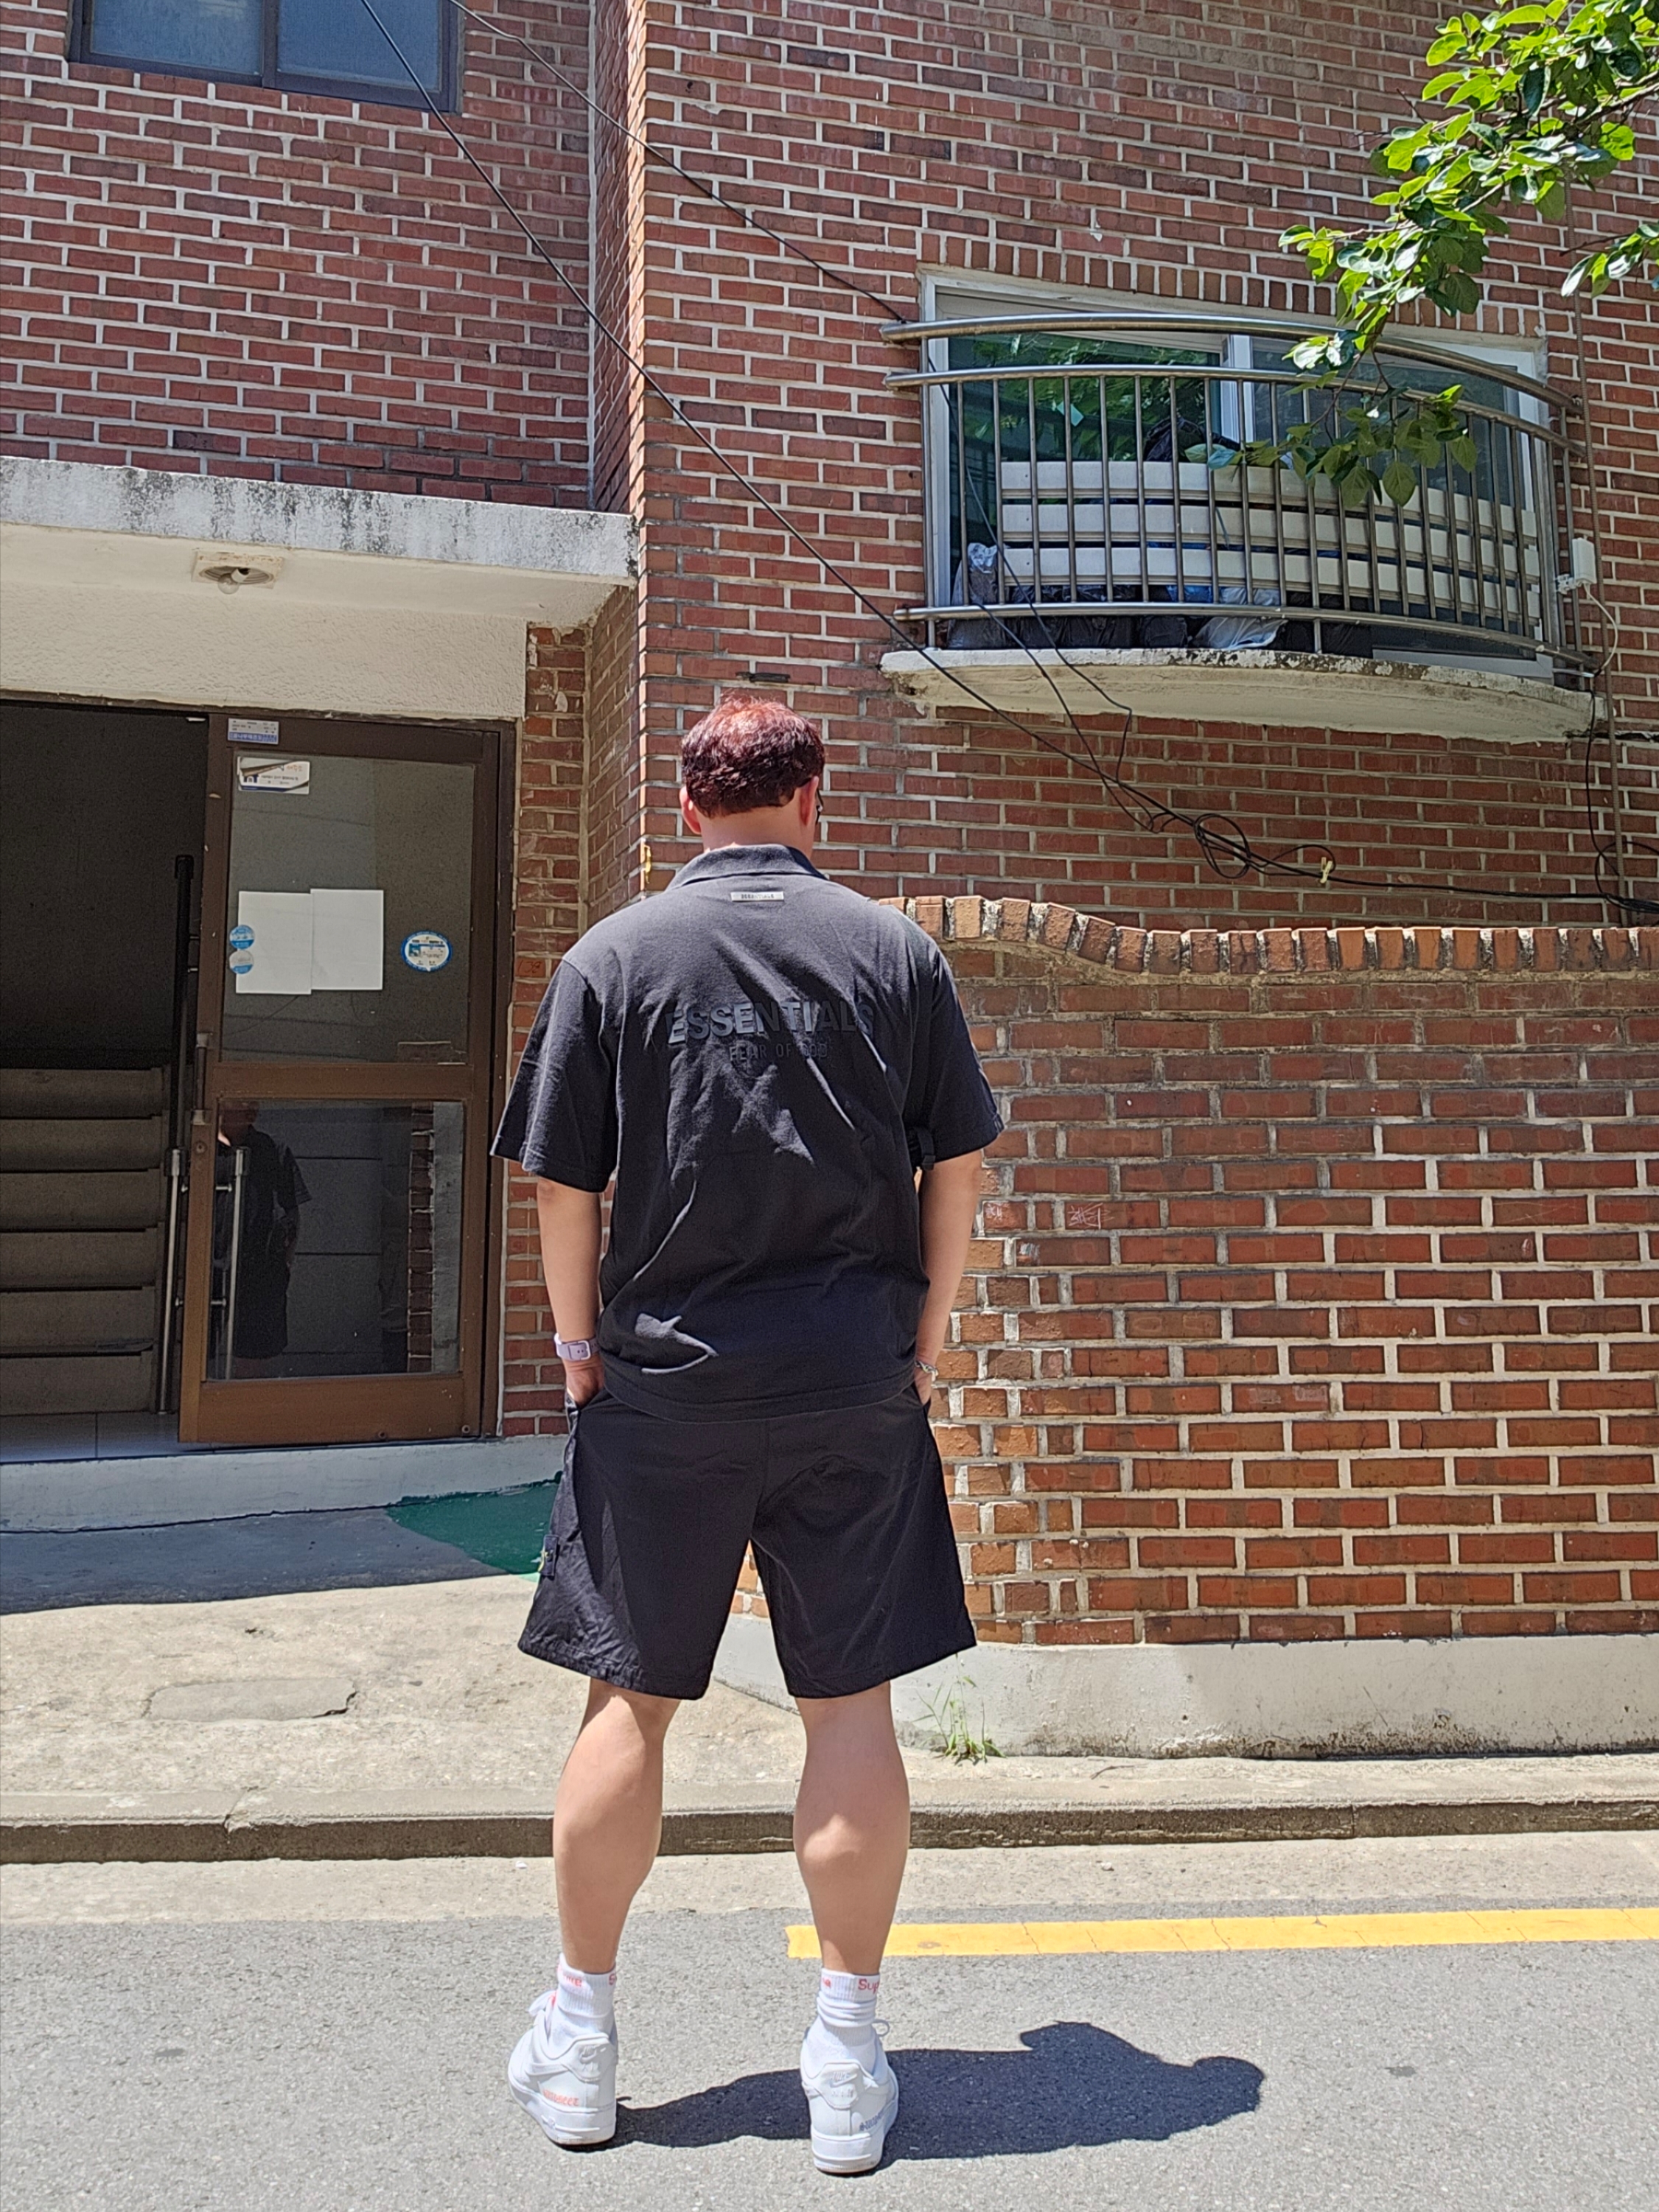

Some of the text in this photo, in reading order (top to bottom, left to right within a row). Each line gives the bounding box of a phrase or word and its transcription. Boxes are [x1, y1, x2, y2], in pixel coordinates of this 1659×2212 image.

[665, 999, 874, 1045] ESSENTIALS
[729, 1044, 767, 1061] FEAR
[775, 1043, 792, 1058] OF
